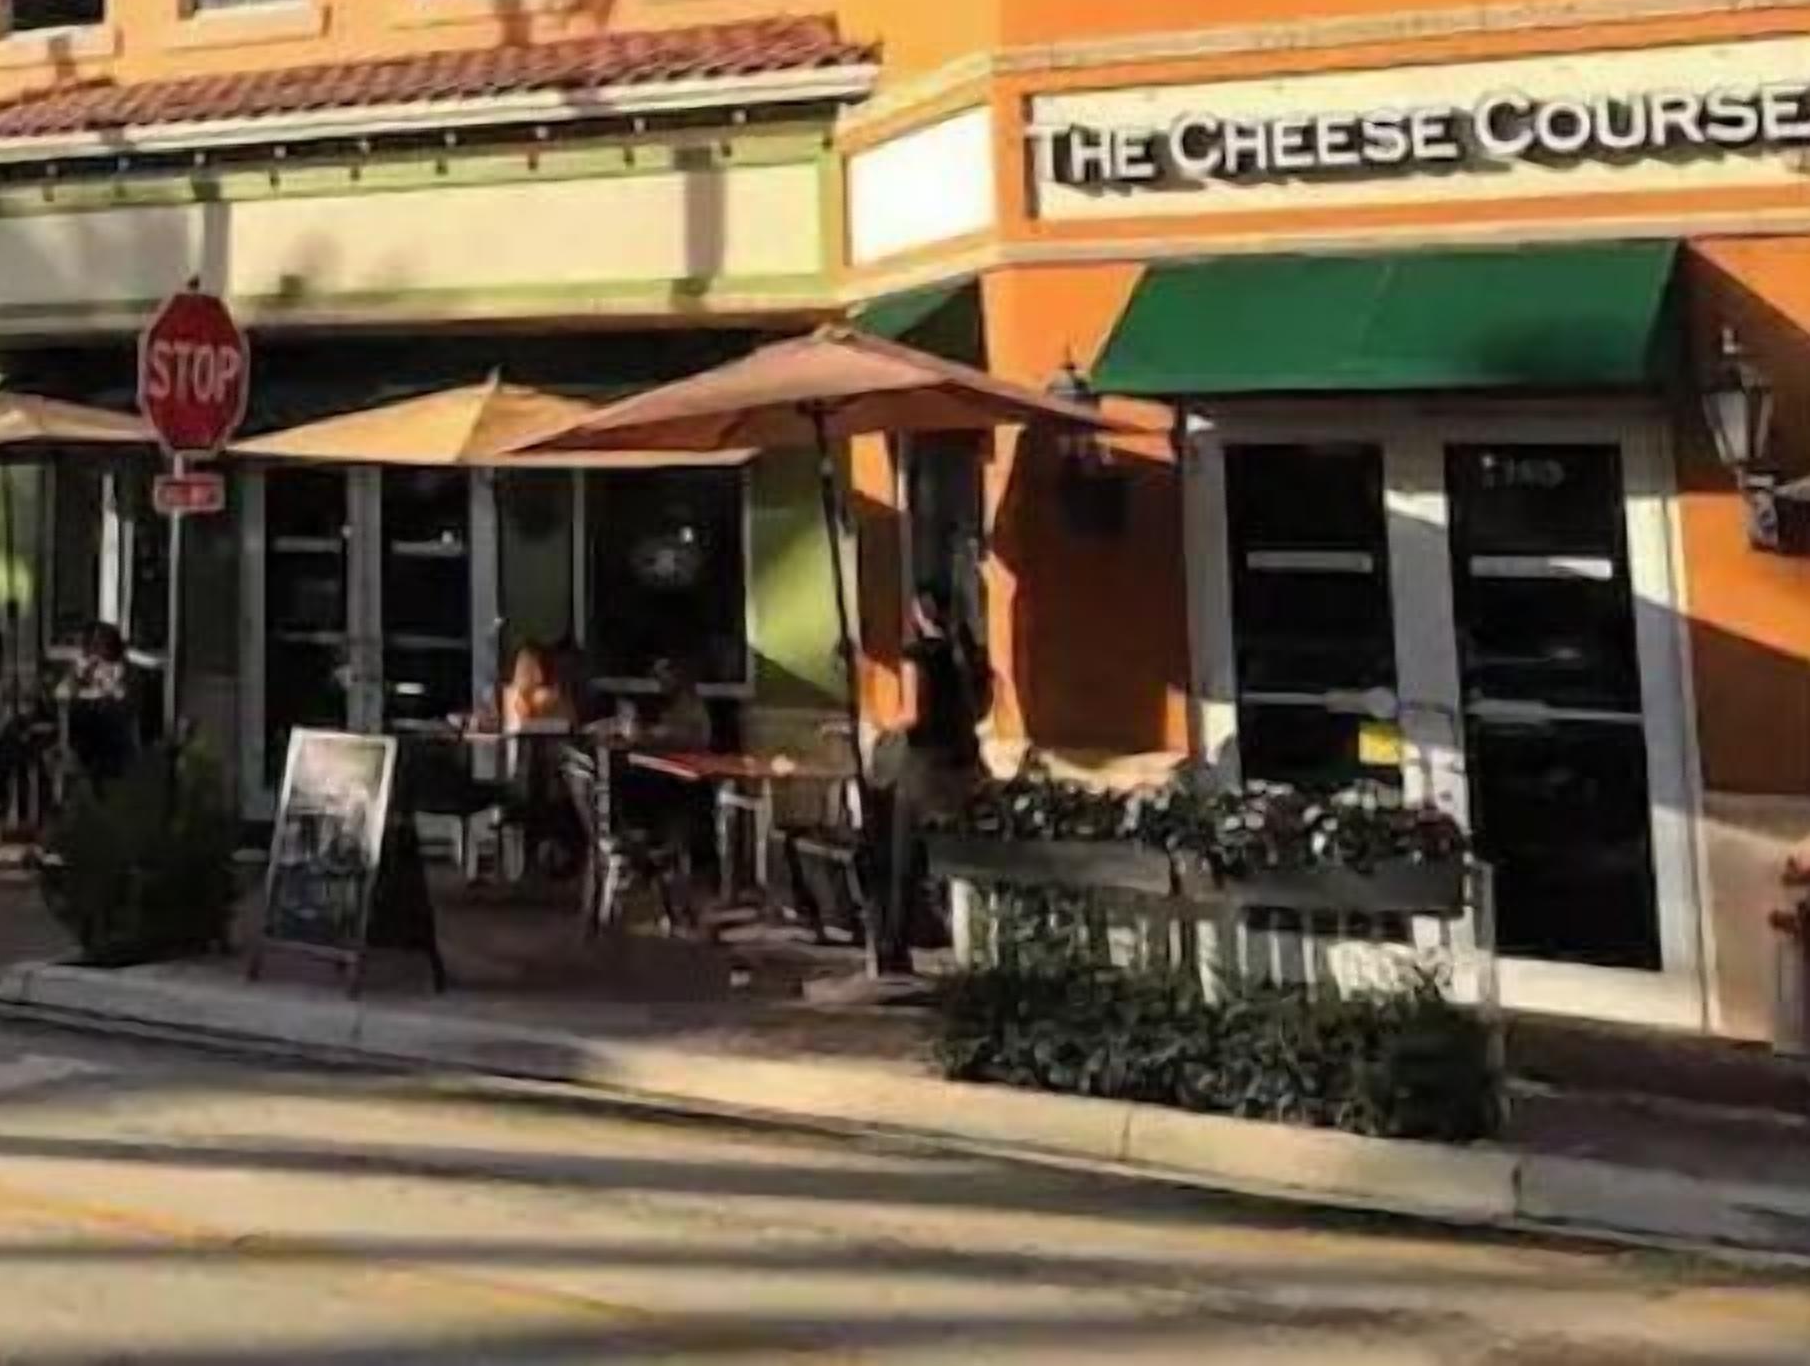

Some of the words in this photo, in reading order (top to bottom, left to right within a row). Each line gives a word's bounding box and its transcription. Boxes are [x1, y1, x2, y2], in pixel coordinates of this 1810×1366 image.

[1028, 122, 1155, 185] THE
[1169, 108, 1458, 173] CHEESE
[1472, 84, 1810, 156] COURSE
[148, 340, 238, 403] STOP
